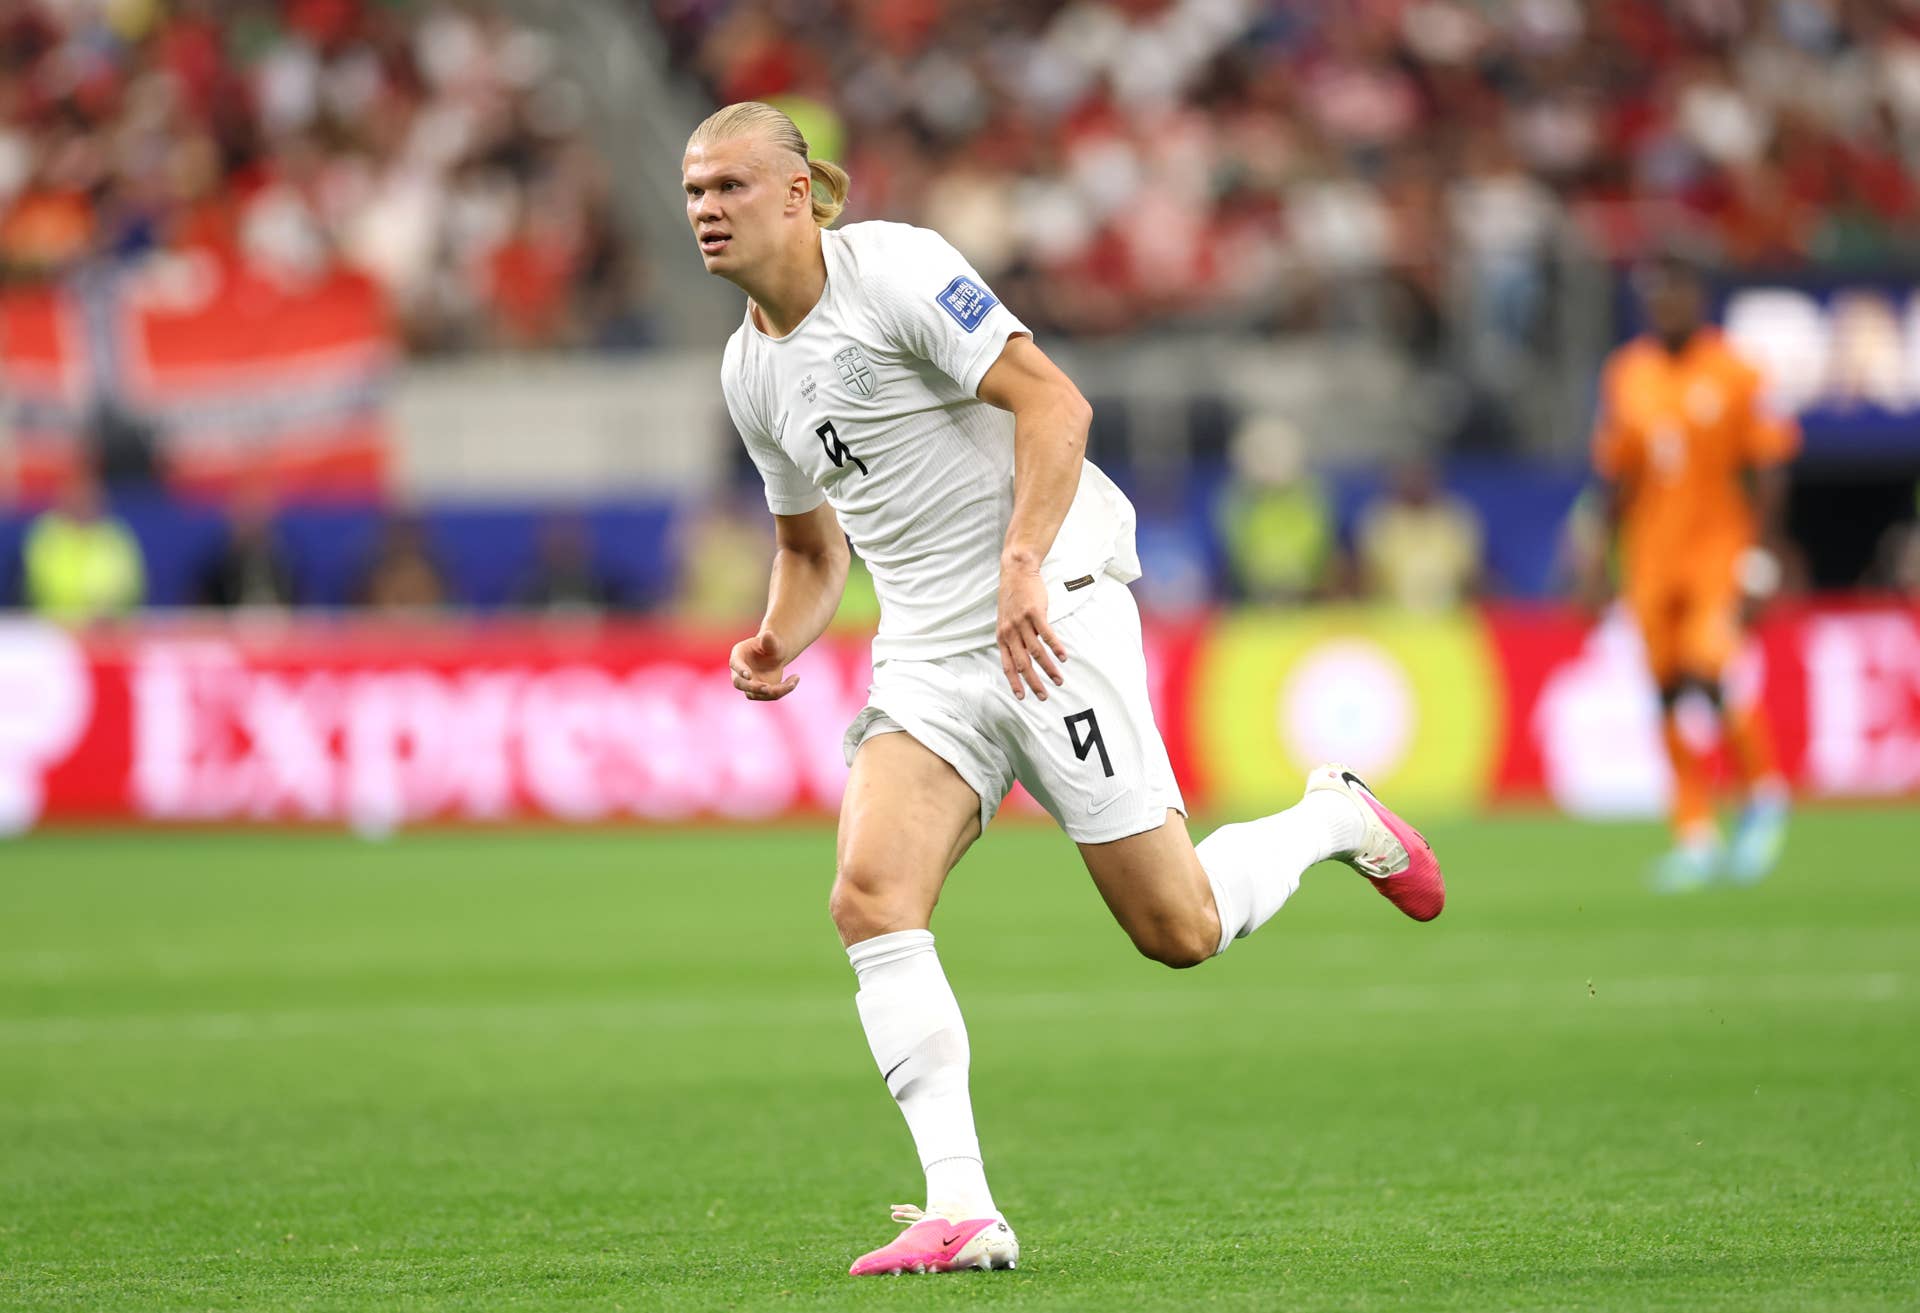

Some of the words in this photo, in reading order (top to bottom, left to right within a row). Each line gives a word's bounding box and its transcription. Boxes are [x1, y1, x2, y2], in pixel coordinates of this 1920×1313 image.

[947, 282, 970, 305] FOOTBALL
[952, 286, 978, 312] UNITES
[815, 420, 868, 476] 9
[1063, 708, 1114, 778] 9
